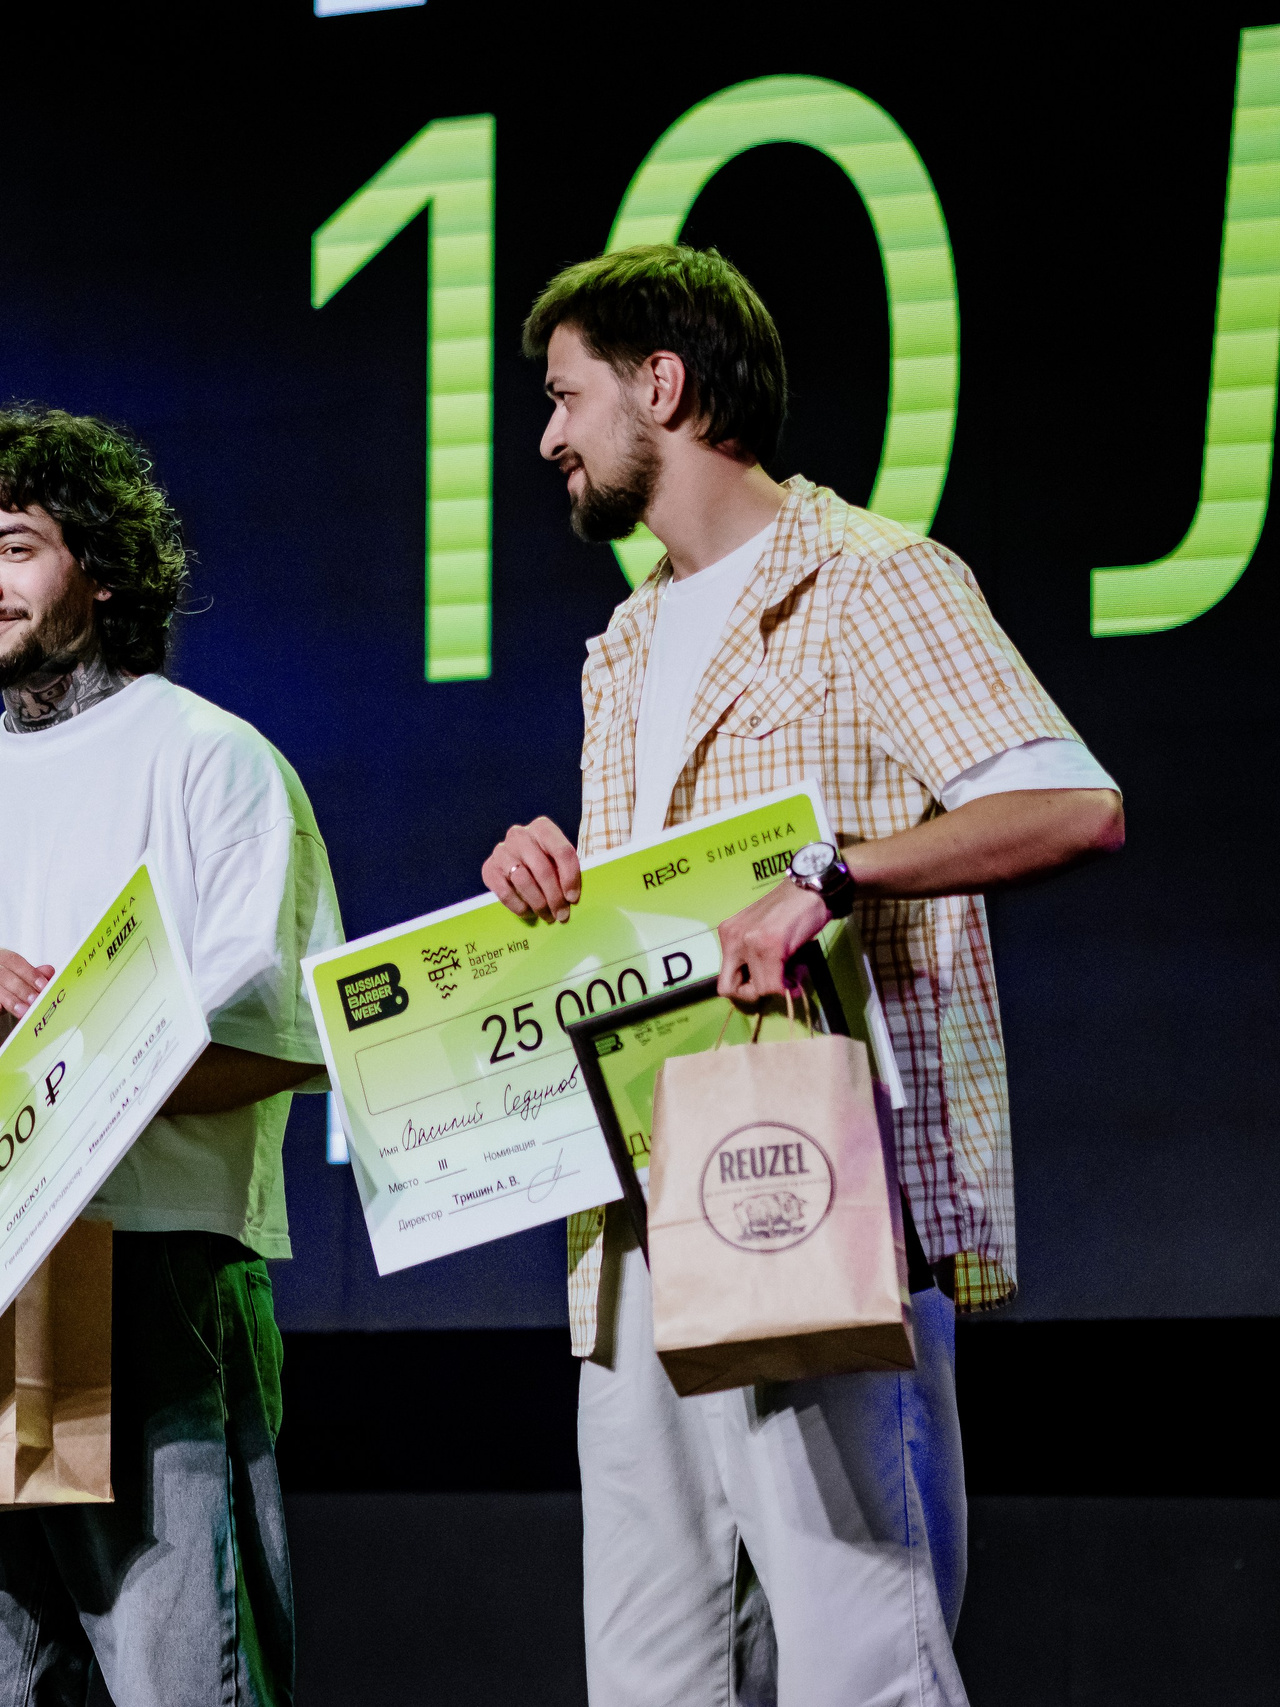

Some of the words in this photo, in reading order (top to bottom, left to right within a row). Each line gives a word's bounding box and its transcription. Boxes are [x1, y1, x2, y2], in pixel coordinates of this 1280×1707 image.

[706, 823, 796, 863] SIMUSHKA
[77, 896, 136, 977] SIMUSHKA
[106, 916, 137, 960] REUZEL
[465, 942, 477, 955] IX
[468, 948, 504, 966] barber
[507, 939, 529, 953] king
[345, 971, 390, 997] RUSSIAN
[348, 985, 392, 1009] BARBER
[351, 1001, 382, 1021] WEEK
[481, 1002, 543, 1064] 25
[45, 1061, 66, 1107] ₽
[6, 1177, 46, 1231] ОЛДСКУЛ
[132, 1019, 166, 1065] 08.10.25
[89, 1111, 121, 1153] Иванова
[121, 1096, 131, 1109] М.
[402, 1101, 488, 1151] Василий
[504, 1062, 581, 1121] Седунов
[379, 1146, 398, 1158] Имя
[388, 1179, 418, 1194] Место
[483, 1139, 536, 1162] Номинация
[719, 1142, 810, 1184] REUZEL
[398, 1210, 443, 1232] Директор
[453, 1186, 493, 1205] Тришин
[496, 1179, 508, 1190] А.
[509, 1175, 520, 1187] В.
